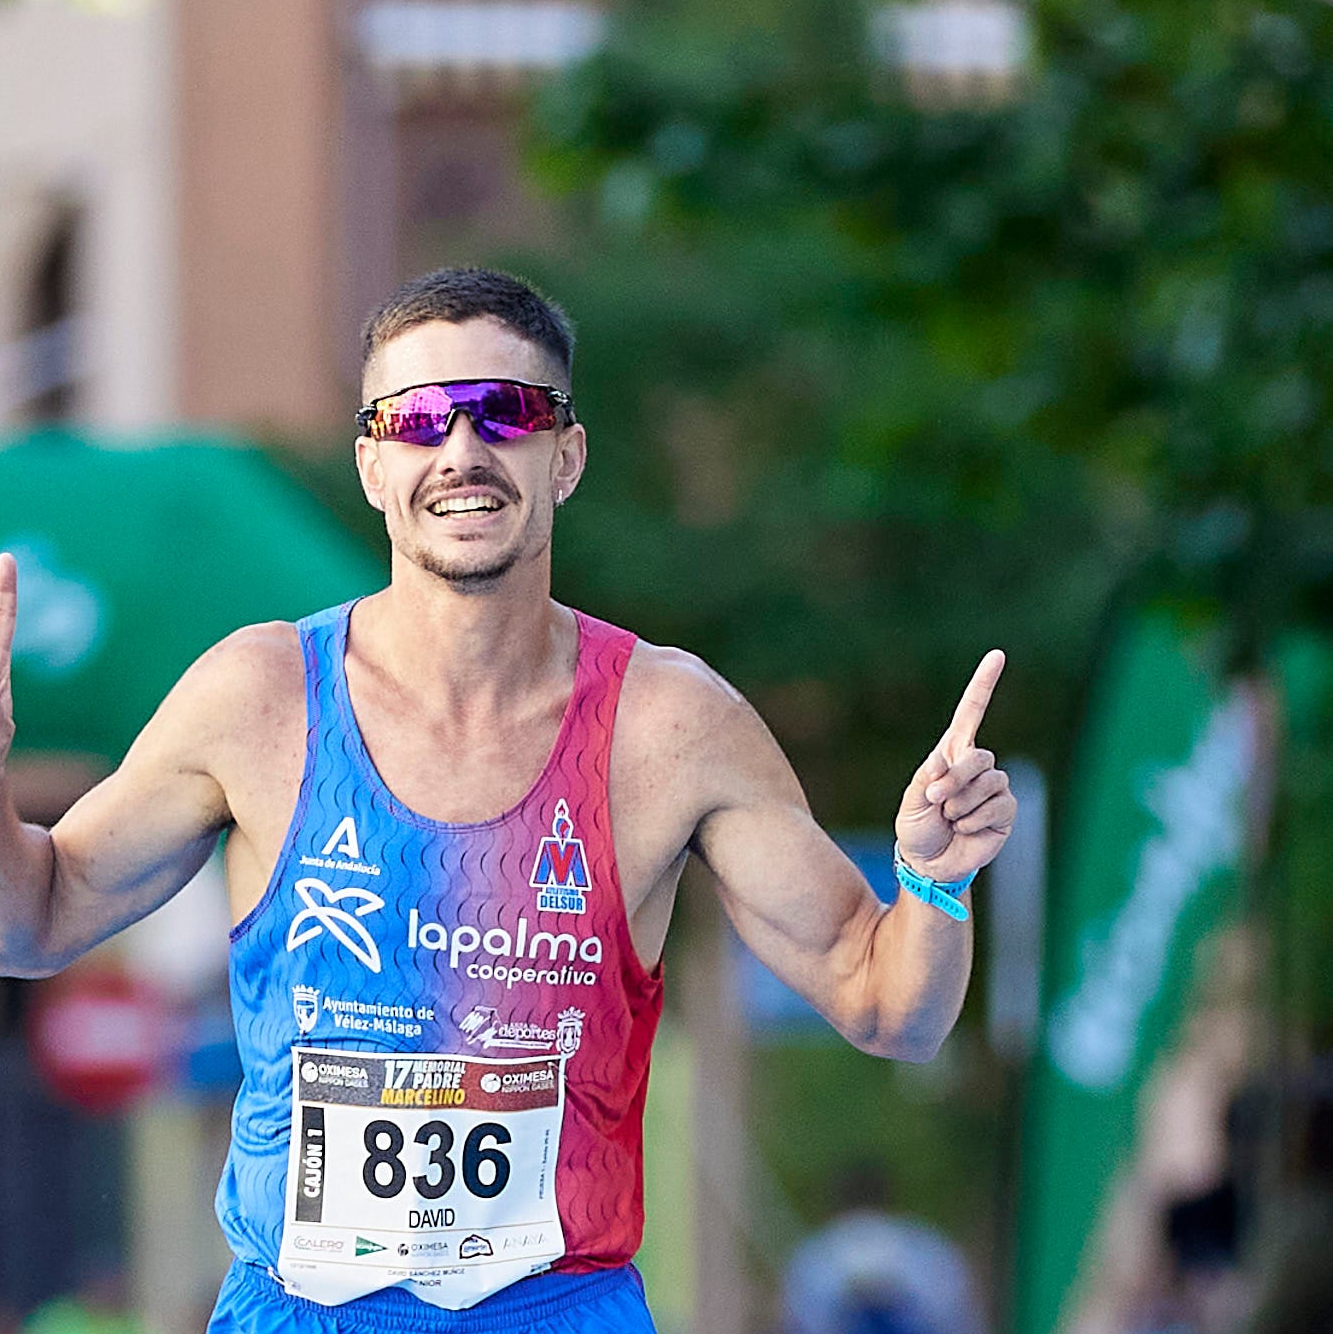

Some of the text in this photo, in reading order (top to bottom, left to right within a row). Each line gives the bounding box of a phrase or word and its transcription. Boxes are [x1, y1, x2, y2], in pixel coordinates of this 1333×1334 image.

[540, 895, 583, 911] DELSUR
[408, 908, 602, 968] lapalma
[466, 963, 597, 989] cooperativa
[323, 996, 435, 1021] Ayuntamiento de
[334, 1013, 423, 1038] Vélez-Málaga
[498, 1024, 556, 1040] deportes
[318, 1064, 368, 1080] OXIMESA
[384, 1060, 413, 1090] 17
[412, 1060, 467, 1075] MEMORIAL
[502, 1069, 555, 1085] OXIMESA
[412, 1073, 463, 1090] PADRE
[380, 1088, 466, 1105] MARCELINO
[302, 1129, 323, 1198] CAJÓN 1
[363, 1120, 511, 1199] 836
[408, 1208, 456, 1229] DAVID
